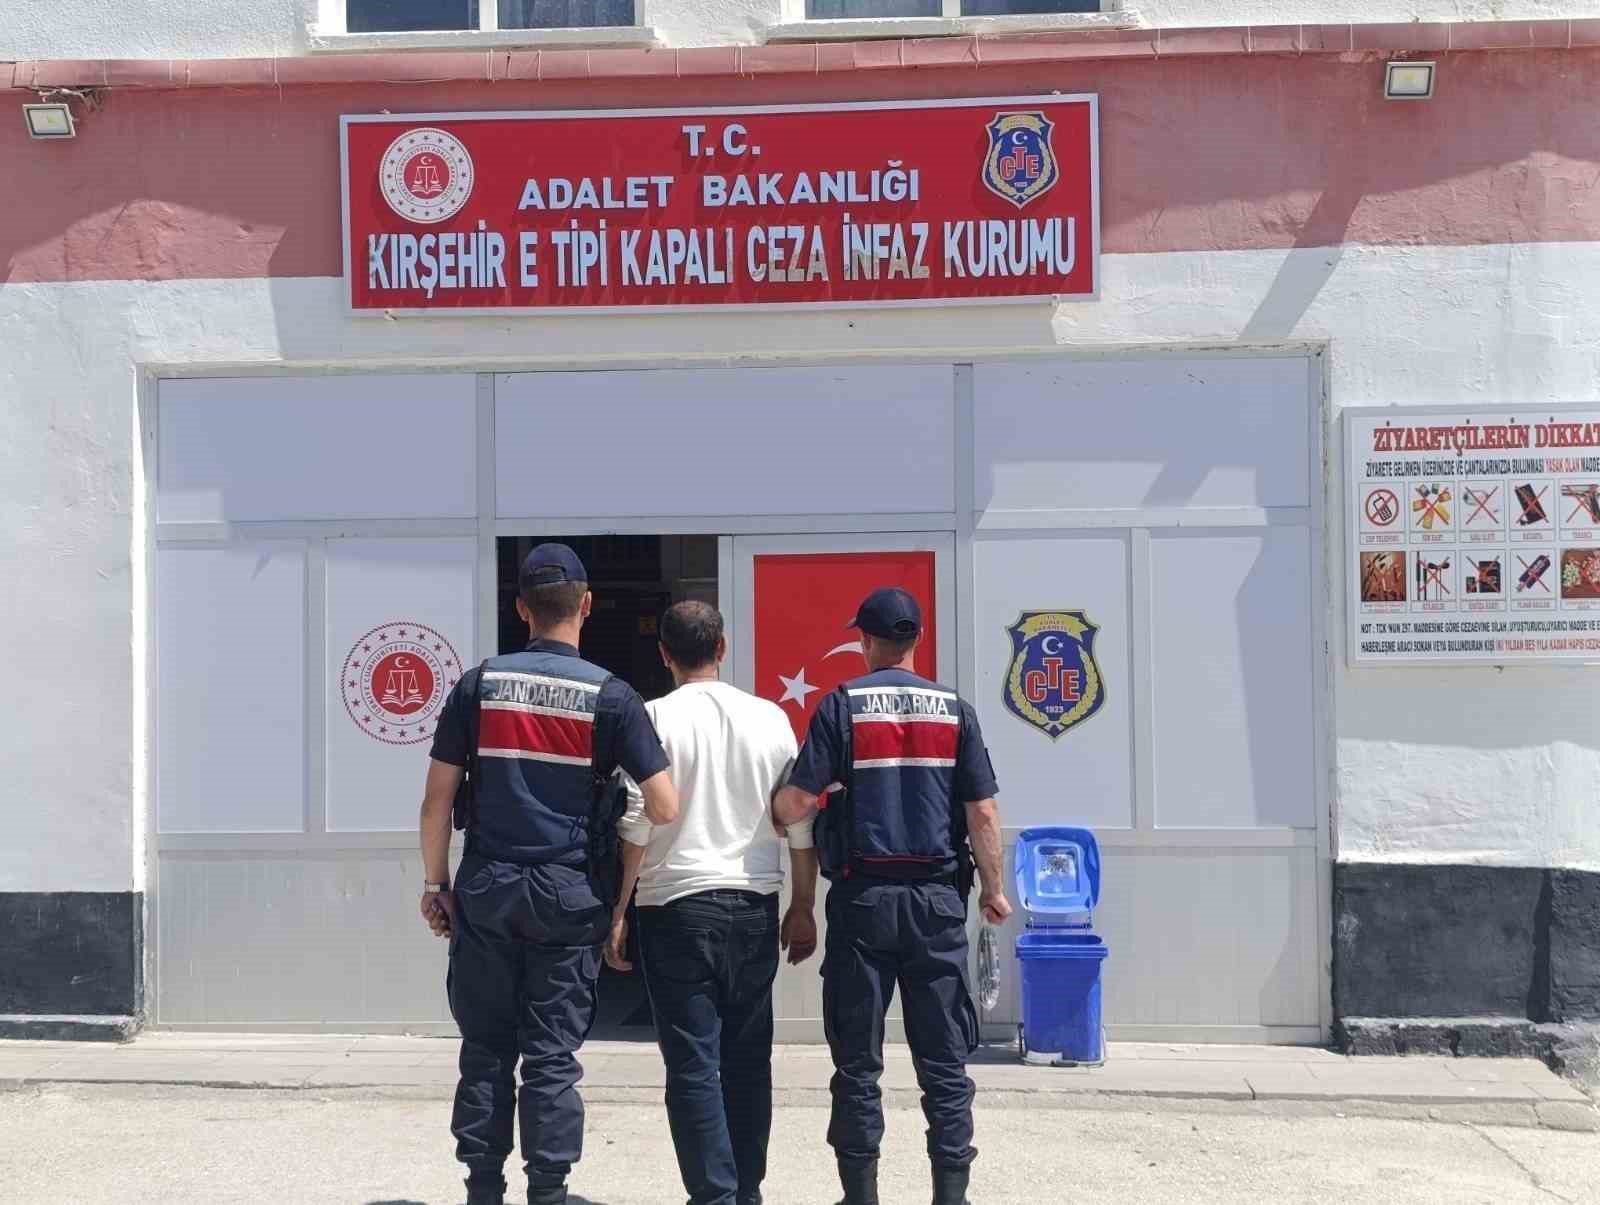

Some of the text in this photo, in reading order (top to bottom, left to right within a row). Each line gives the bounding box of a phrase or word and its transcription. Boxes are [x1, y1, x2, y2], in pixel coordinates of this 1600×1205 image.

[682, 124, 760, 156] T. C.
[1000, 147, 1039, 180] CTE
[518, 159, 919, 210] ADALET BAKANLIĞI
[368, 212, 1076, 299] KIRŞEHİR E TİPİ KAPALI CEZA İNFAZ KURUMU
[1373, 417, 1530, 456] ZİYARETÇİLERİN
[1366, 459, 1392, 477] ZİYARETE
[1456, 459, 1463, 475] VE
[494, 680, 586, 711] JANDARMA
[1025, 657, 1080, 702] CTE
[862, 693, 949, 714] JANDARMA
